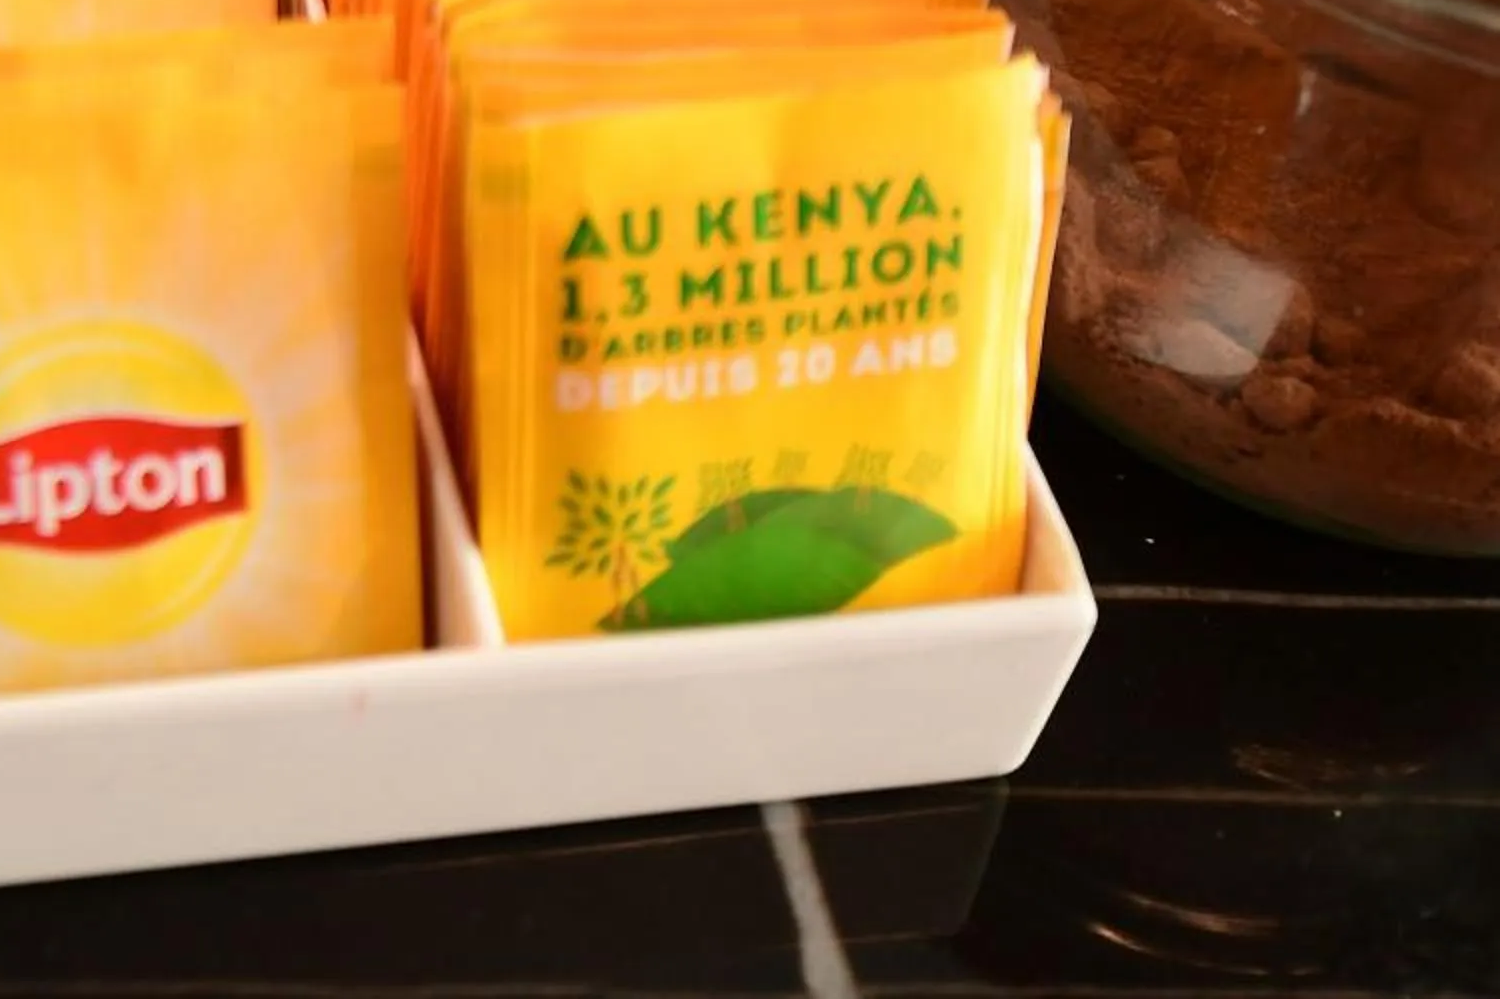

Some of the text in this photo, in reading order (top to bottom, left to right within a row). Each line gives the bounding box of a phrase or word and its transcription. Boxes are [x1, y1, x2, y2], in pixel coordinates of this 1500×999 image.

[562, 205, 663, 261] AU
[678, 233, 964, 312] MILLION
[556, 327, 959, 413] DEPUIS 20 ANS
